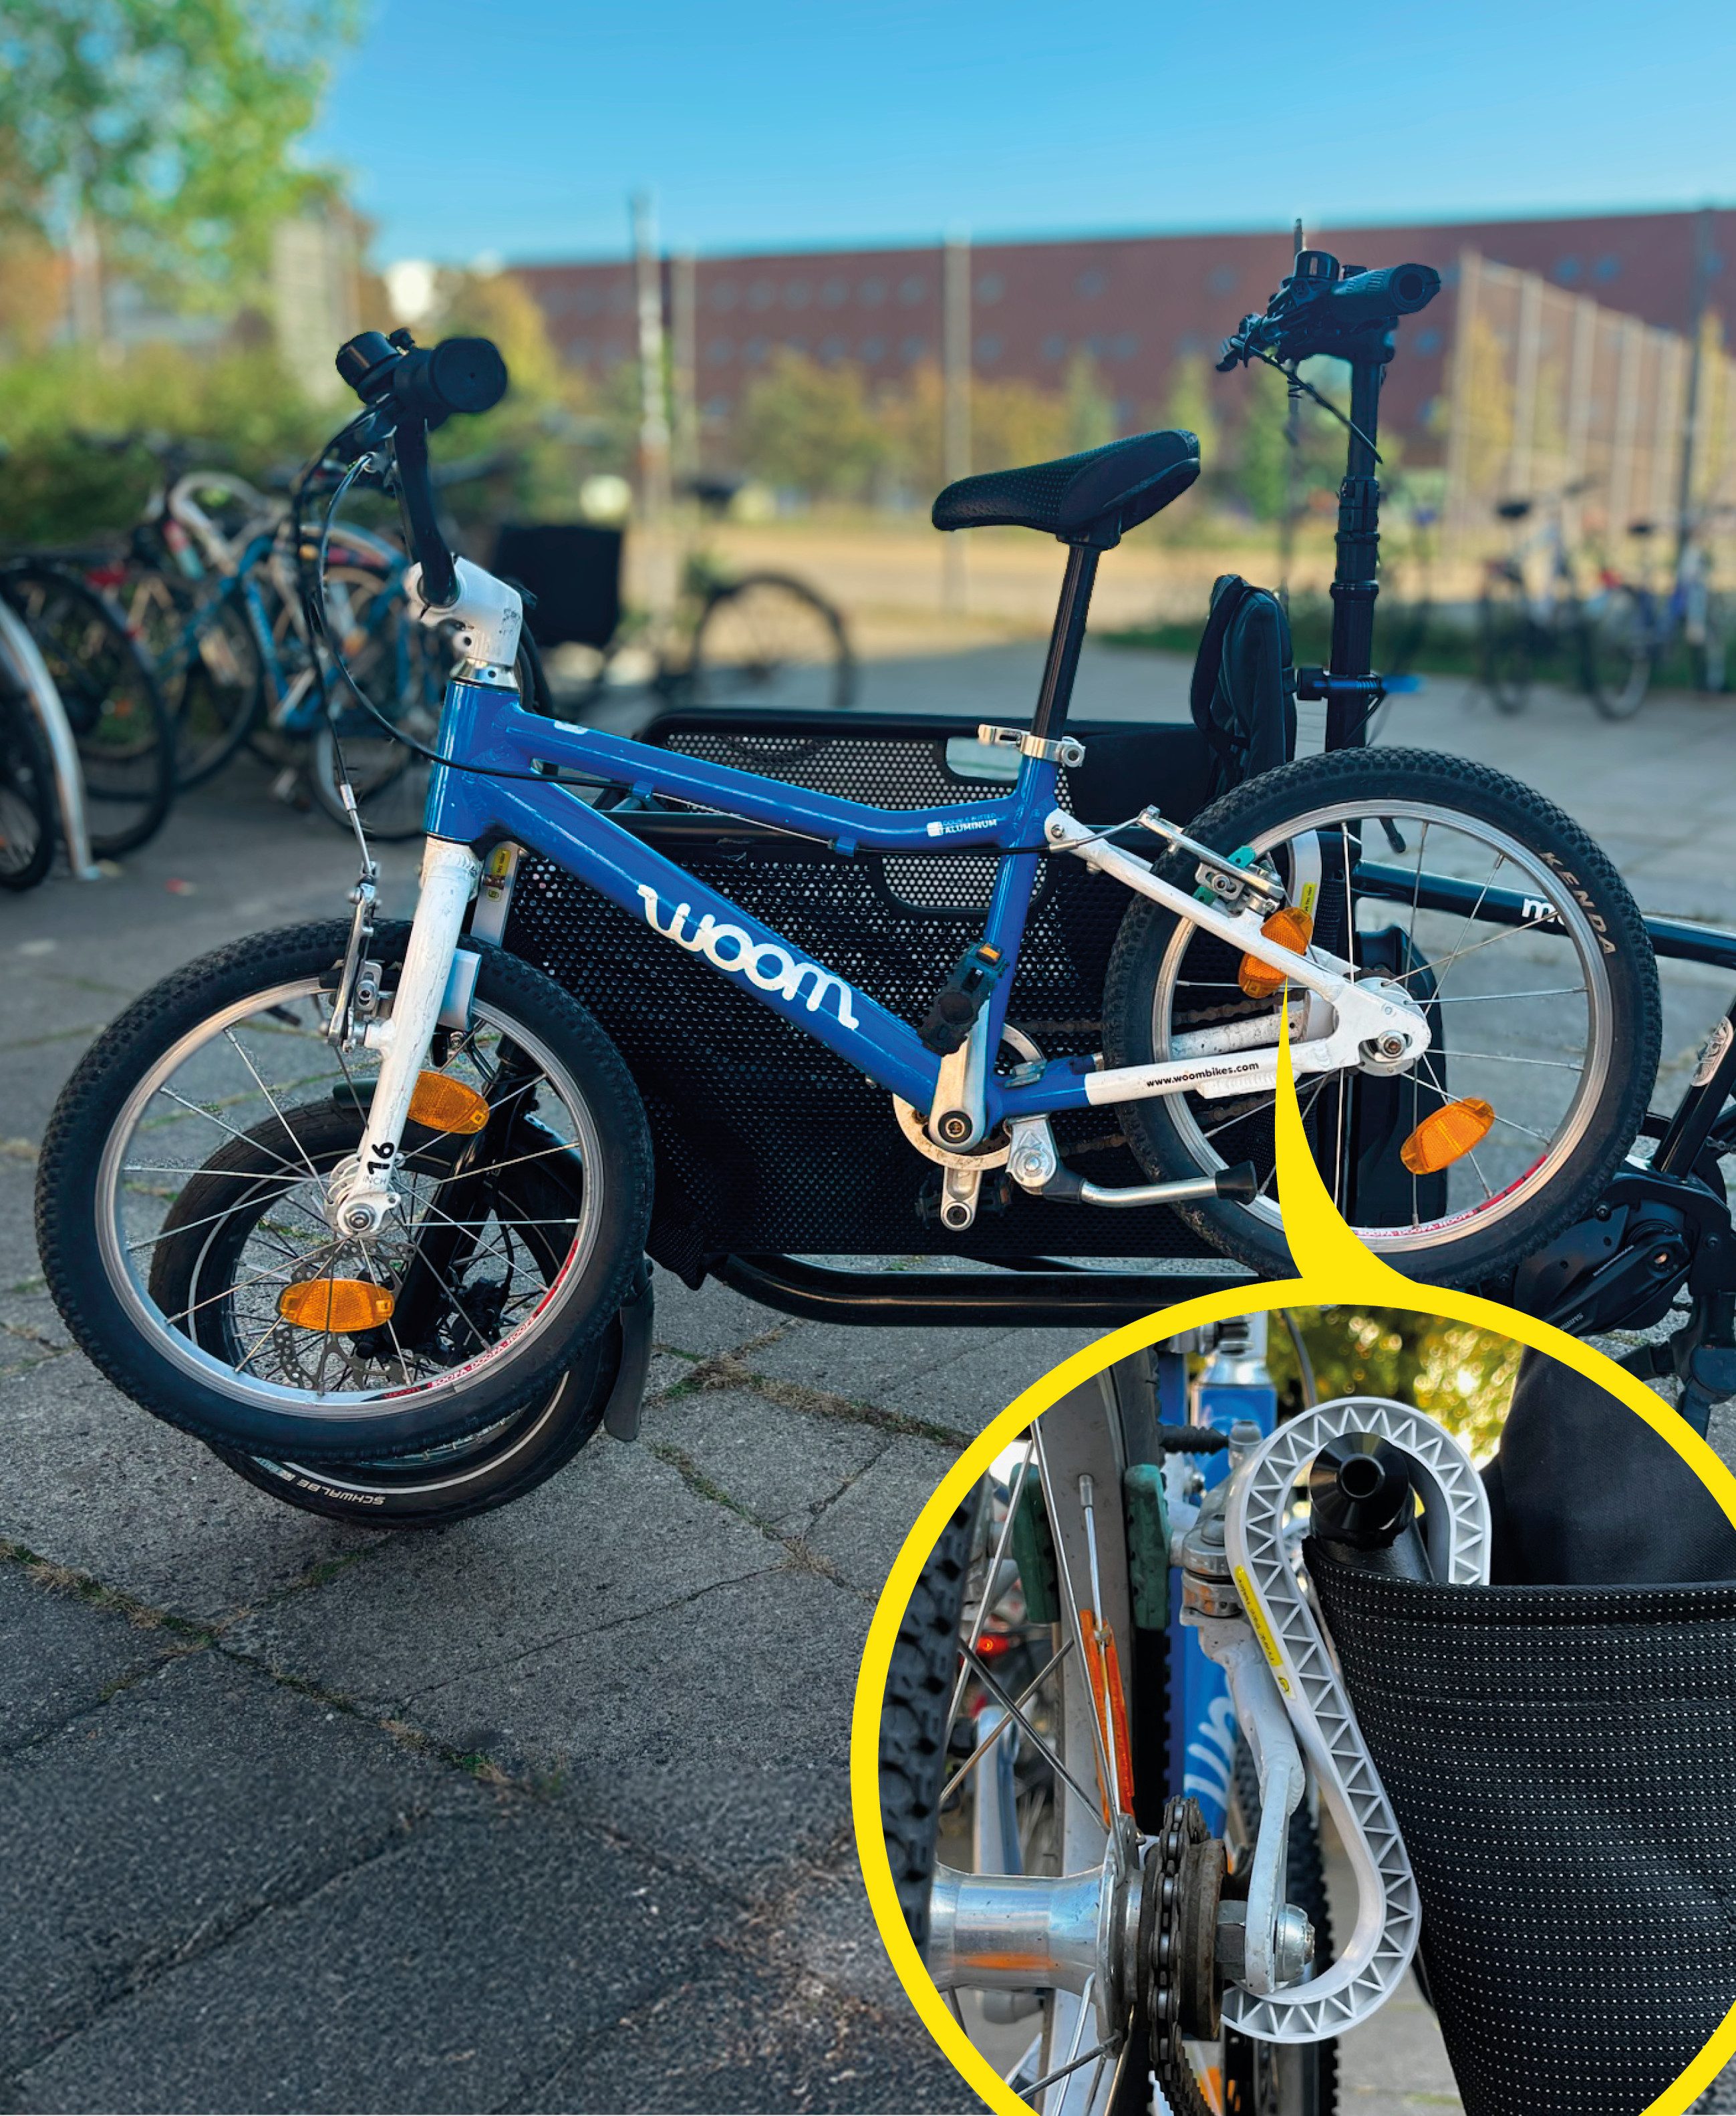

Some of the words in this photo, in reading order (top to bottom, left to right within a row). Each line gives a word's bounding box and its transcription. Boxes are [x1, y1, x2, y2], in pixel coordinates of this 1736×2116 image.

[1538, 852, 1617, 953] KENDA
[637, 883, 860, 1030] woom
[1146, 1062, 1260, 1087] www.woombikes.com
[367, 1141, 395, 1175] 16
[296, 1478, 386, 1505] SCHWALBE
